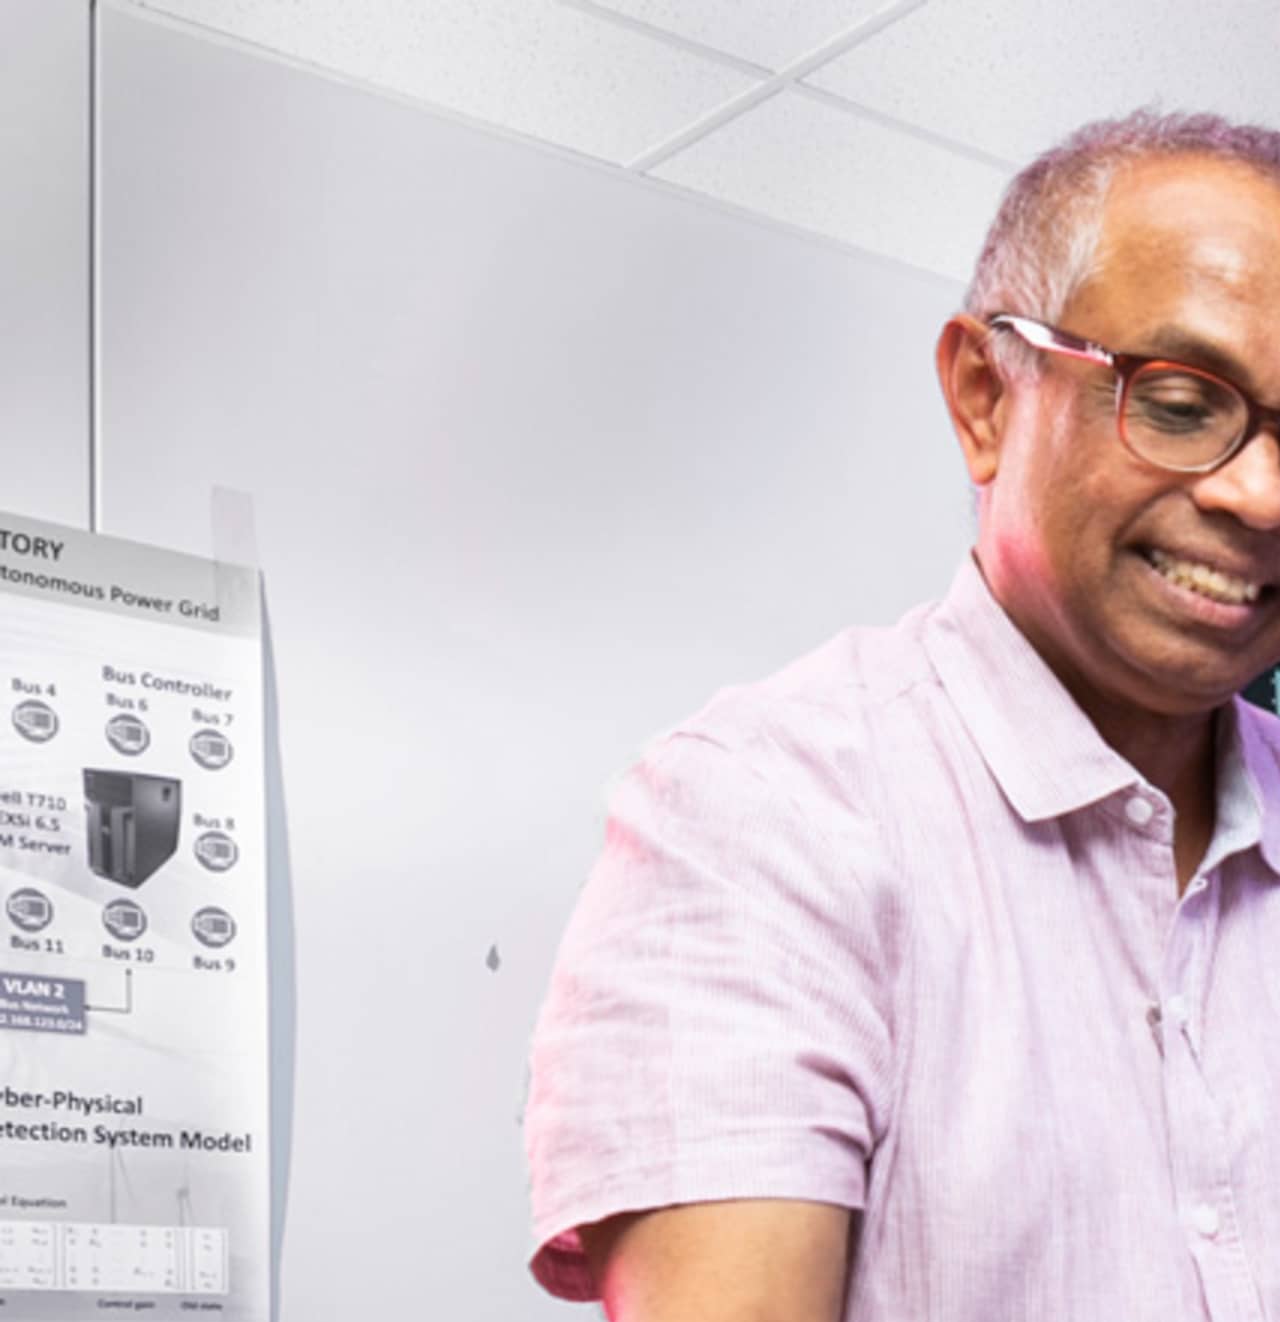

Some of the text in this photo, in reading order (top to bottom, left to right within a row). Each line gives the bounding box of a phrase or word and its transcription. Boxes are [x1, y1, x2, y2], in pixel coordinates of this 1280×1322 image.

[0, 530, 64, 561] TORY
[110, 586, 173, 613] Power
[178, 599, 220, 622] Grid
[11, 677, 56, 697] Bus 4
[102, 665, 232, 702] Bus Controller
[106, 692, 134, 709] Bus
[191, 707, 220, 725] Bus
[27, 792, 66, 811] T710
[35, 815, 60, 833] 6.5
[193, 813, 221, 829] Bus
[19, 835, 71, 855] Server
[10, 935, 64, 954] Bus 11
[102, 944, 154, 963] Bus 10
[193, 955, 236, 972] Bus 9
[3, 978, 64, 998] VLAN 2
[94, 1125, 174, 1149] System
[180, 1130, 251, 1152] Model
